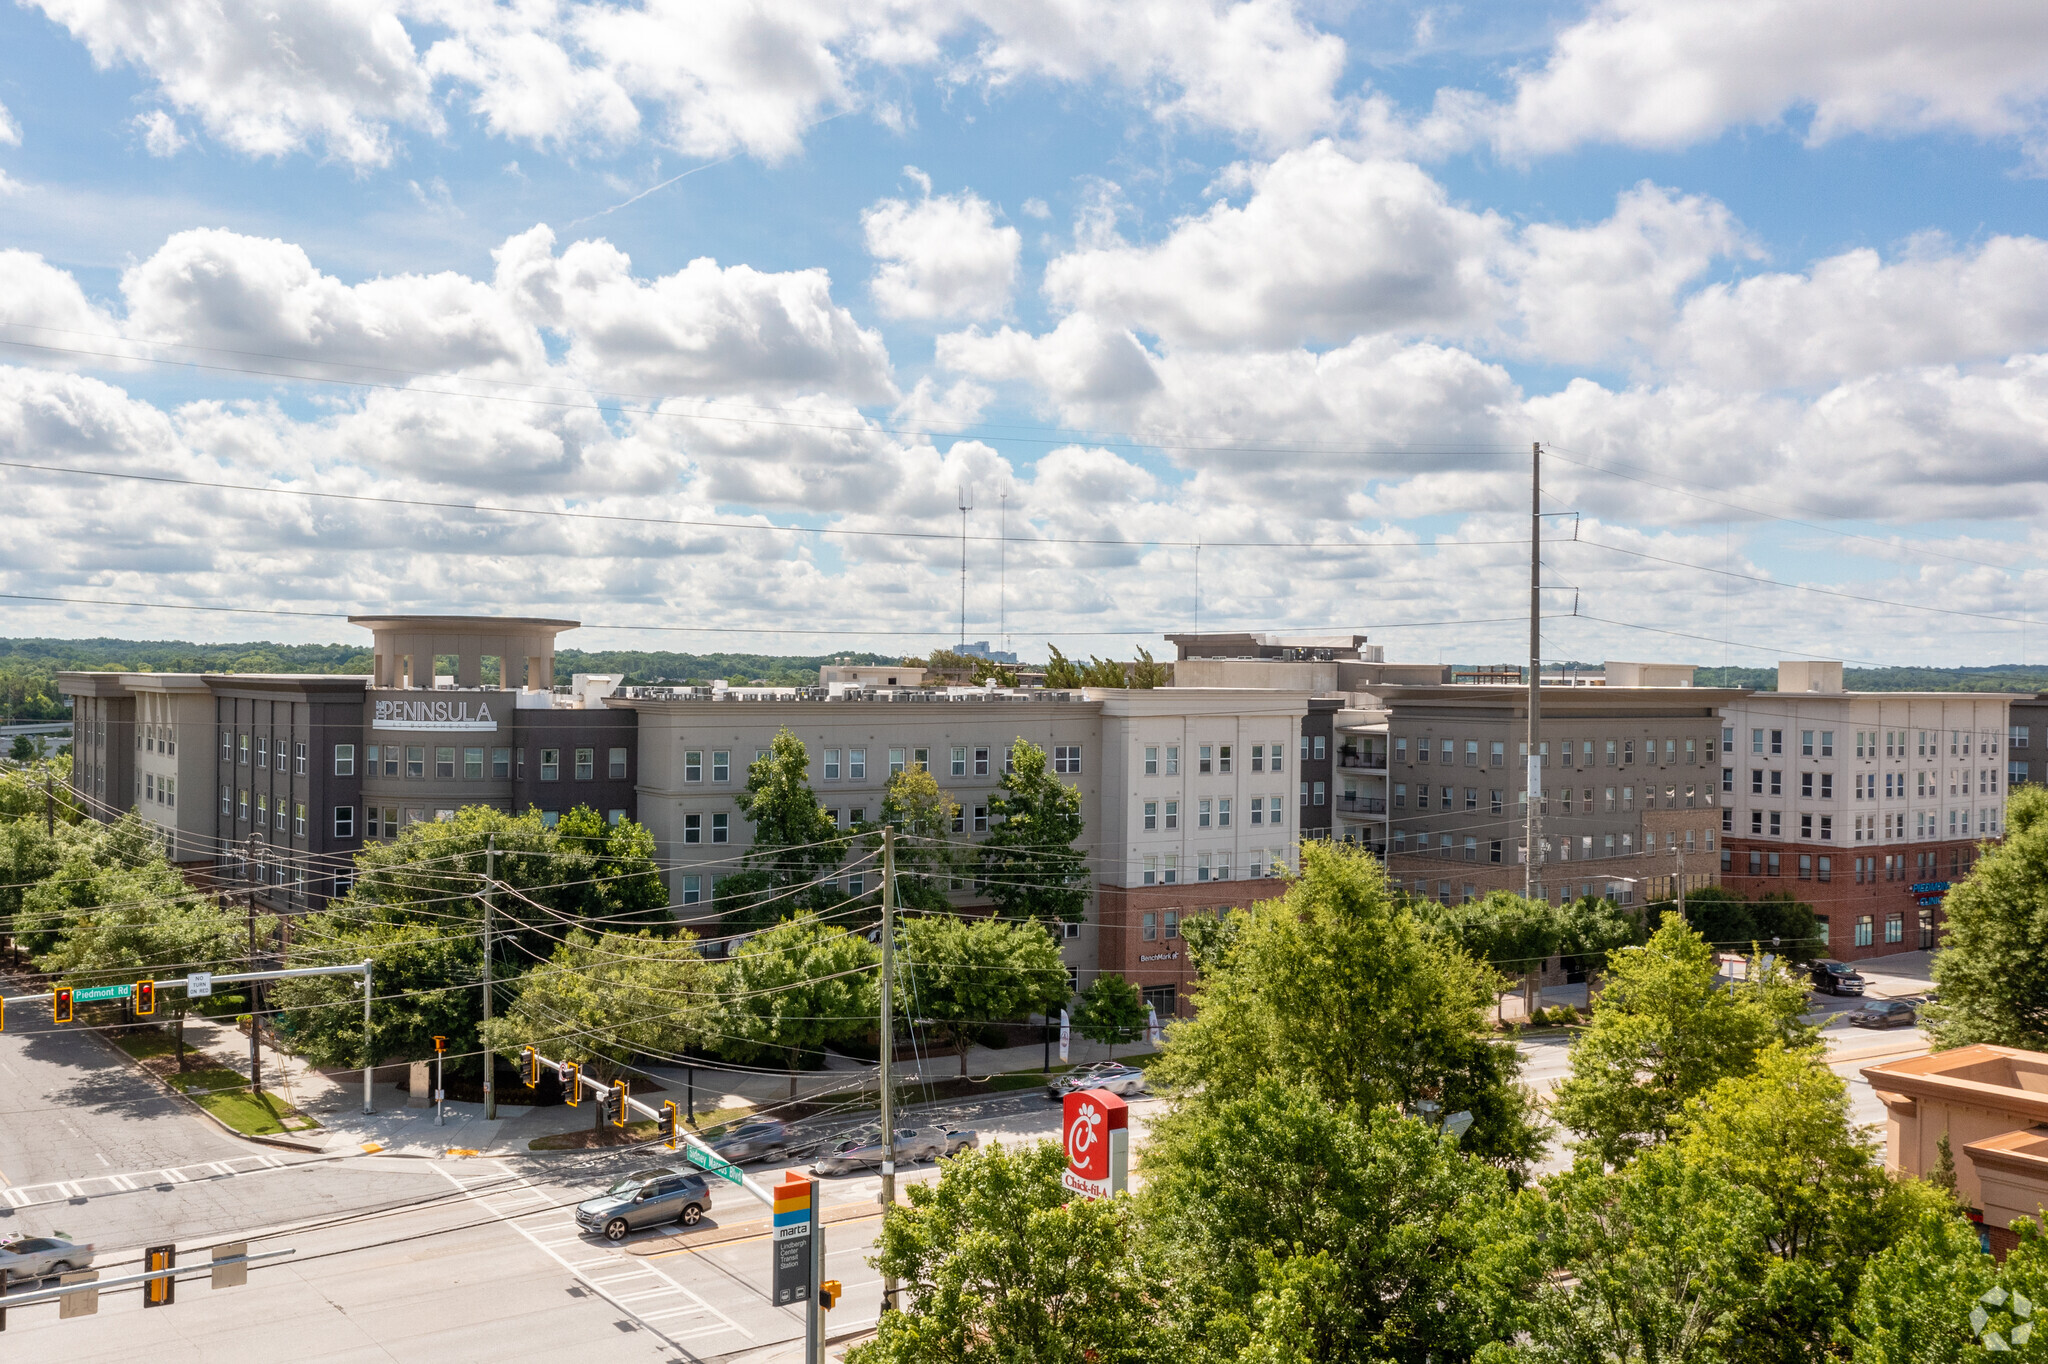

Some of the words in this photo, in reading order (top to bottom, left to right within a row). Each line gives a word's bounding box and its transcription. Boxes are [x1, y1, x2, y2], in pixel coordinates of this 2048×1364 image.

[376, 700, 385, 720] THE
[385, 700, 493, 721] PENINSULA
[1141, 953, 1171, 962] BenchMark
[76, 987, 115, 999] Piedmont
[118, 986, 129, 995] Rd
[729, 1165, 742, 1183] Blvd
[1065, 1174, 1107, 1198] Chick-fil-A
[780, 1225, 807, 1237] marta
[780, 1240, 806, 1250] Lindbergh
[780, 1248, 798, 1256] Center
[781, 1254, 798, 1262] Transit
[780, 1261, 798, 1269] Station
